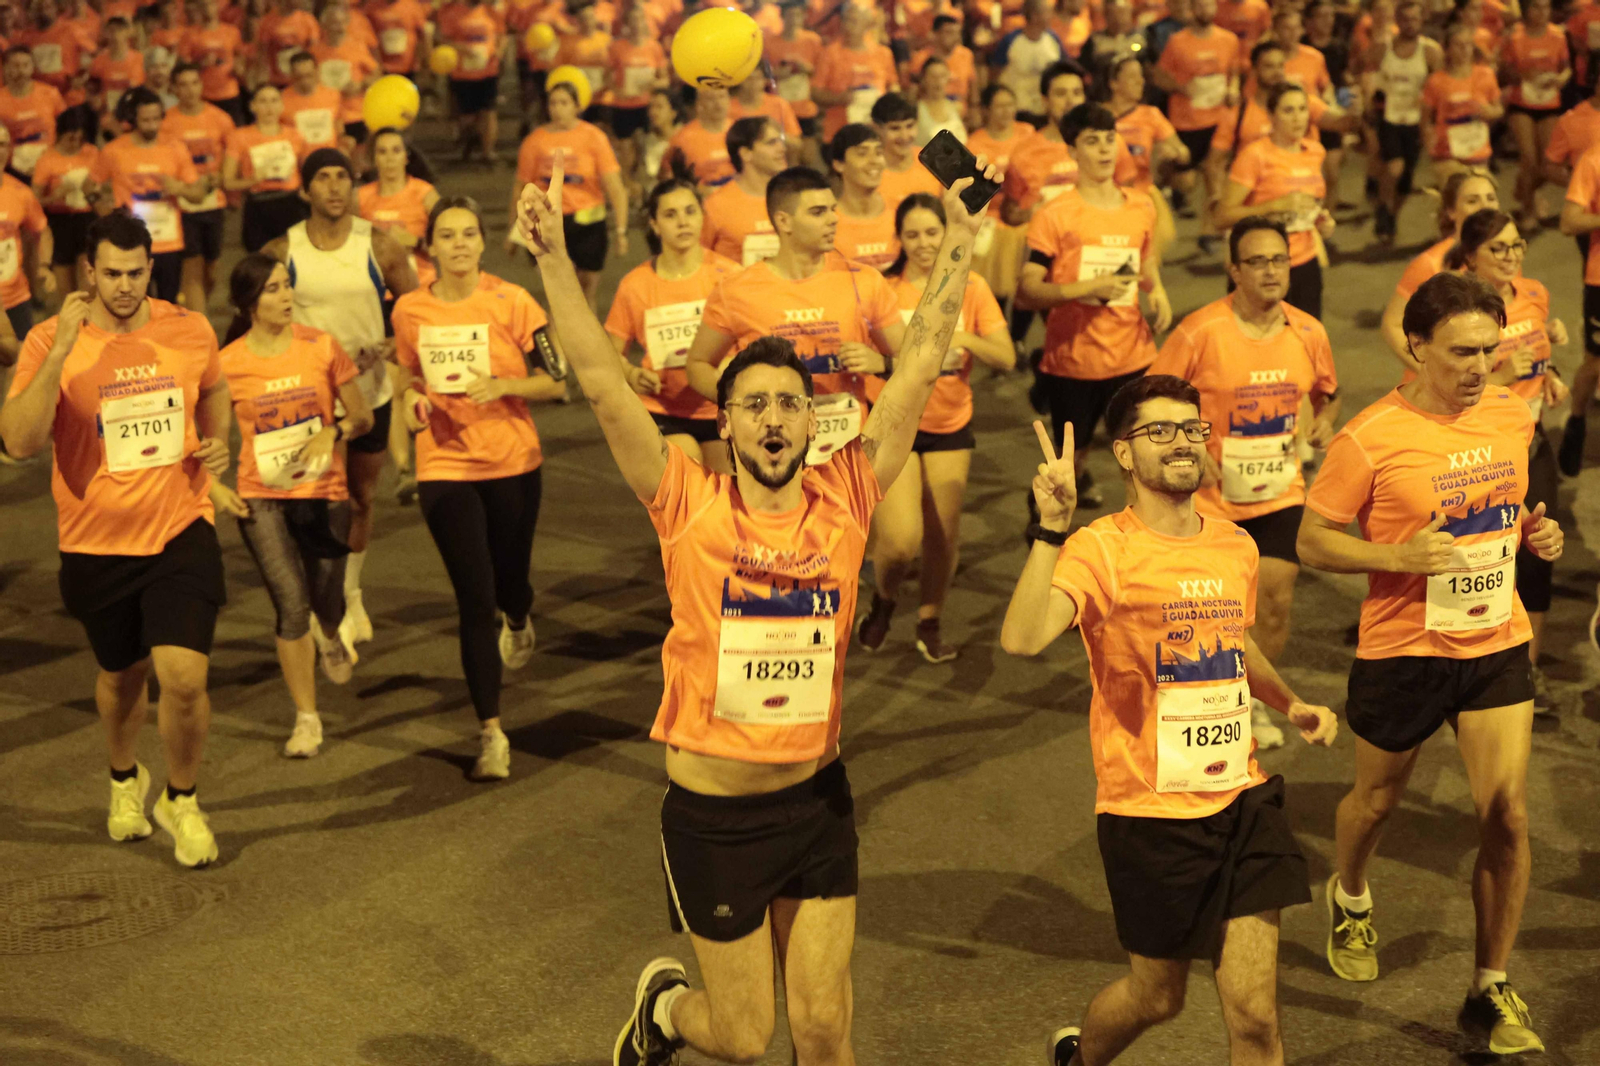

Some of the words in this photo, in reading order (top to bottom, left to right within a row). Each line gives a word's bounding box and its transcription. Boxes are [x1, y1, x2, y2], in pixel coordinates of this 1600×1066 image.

[784, 307, 825, 322] XXXV
[429, 349, 476, 364] 20145
[114, 363, 158, 382] XXXV
[1249, 368, 1288, 384] XXXV
[264, 373, 302, 393] XXXV
[120, 417, 172, 439] 21701
[1447, 445, 1492, 470] XXXV
[1237, 461, 1284, 476] 16744
[1431, 469, 1468, 483] CARRERA
[1471, 460, 1514, 475] NOCTURNA
[1439, 467, 1516, 491] GUADALQUIVIR
[1177, 579, 1223, 599] XXXV
[1448, 570, 1504, 594] 13669
[1162, 600, 1199, 611] CARRERA
[1201, 599, 1242, 608] NOCTURNA
[1169, 608, 1244, 622] GUADALQUIVIR
[742, 658, 815, 682] 18293
[1157, 674, 1175, 682] 2023
[1181, 720, 1241, 747] 18290
